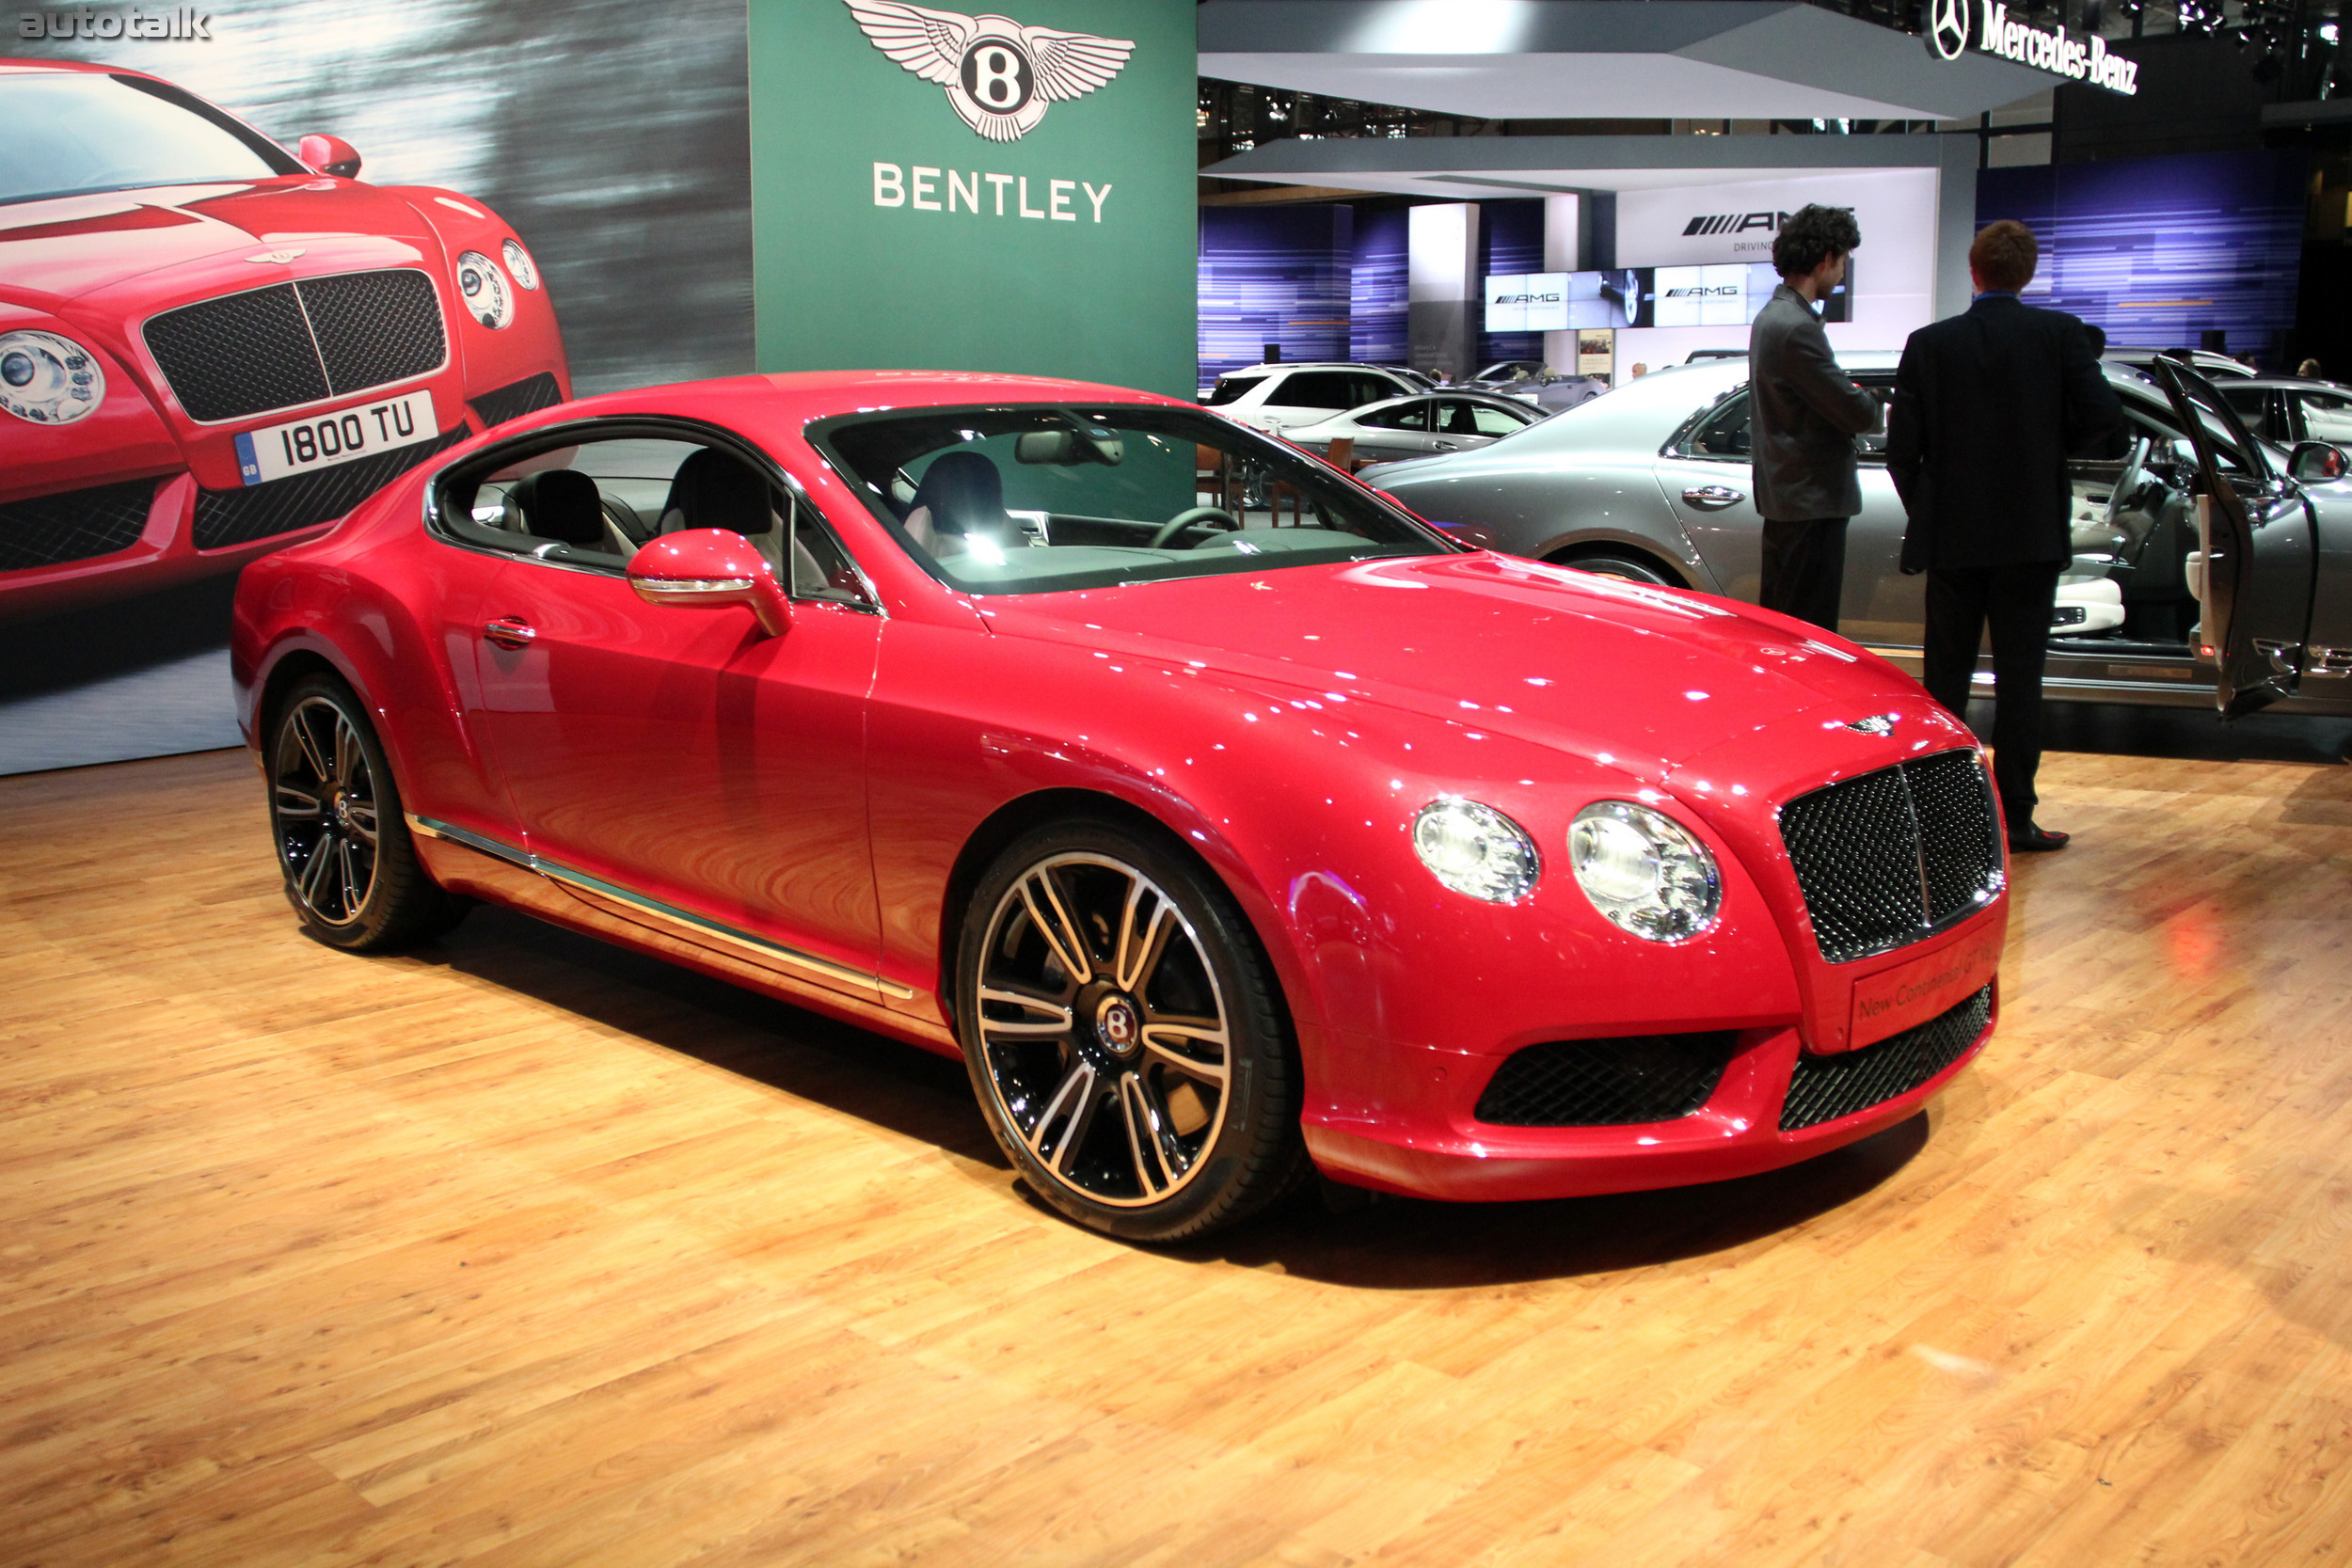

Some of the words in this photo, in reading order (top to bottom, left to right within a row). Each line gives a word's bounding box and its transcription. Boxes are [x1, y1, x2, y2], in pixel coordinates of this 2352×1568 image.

[1980, 0, 2138, 95] Mercedes-Benz
[973, 45, 1021, 108] B
[873, 161, 1112, 222] BENTLEY
[1514, 293, 1560, 303] AMG
[1687, 286, 1738, 296] AMG
[370, 400, 415, 442] TU
[242, 464, 258, 477] GB
[1859, 996, 1893, 1022] New
